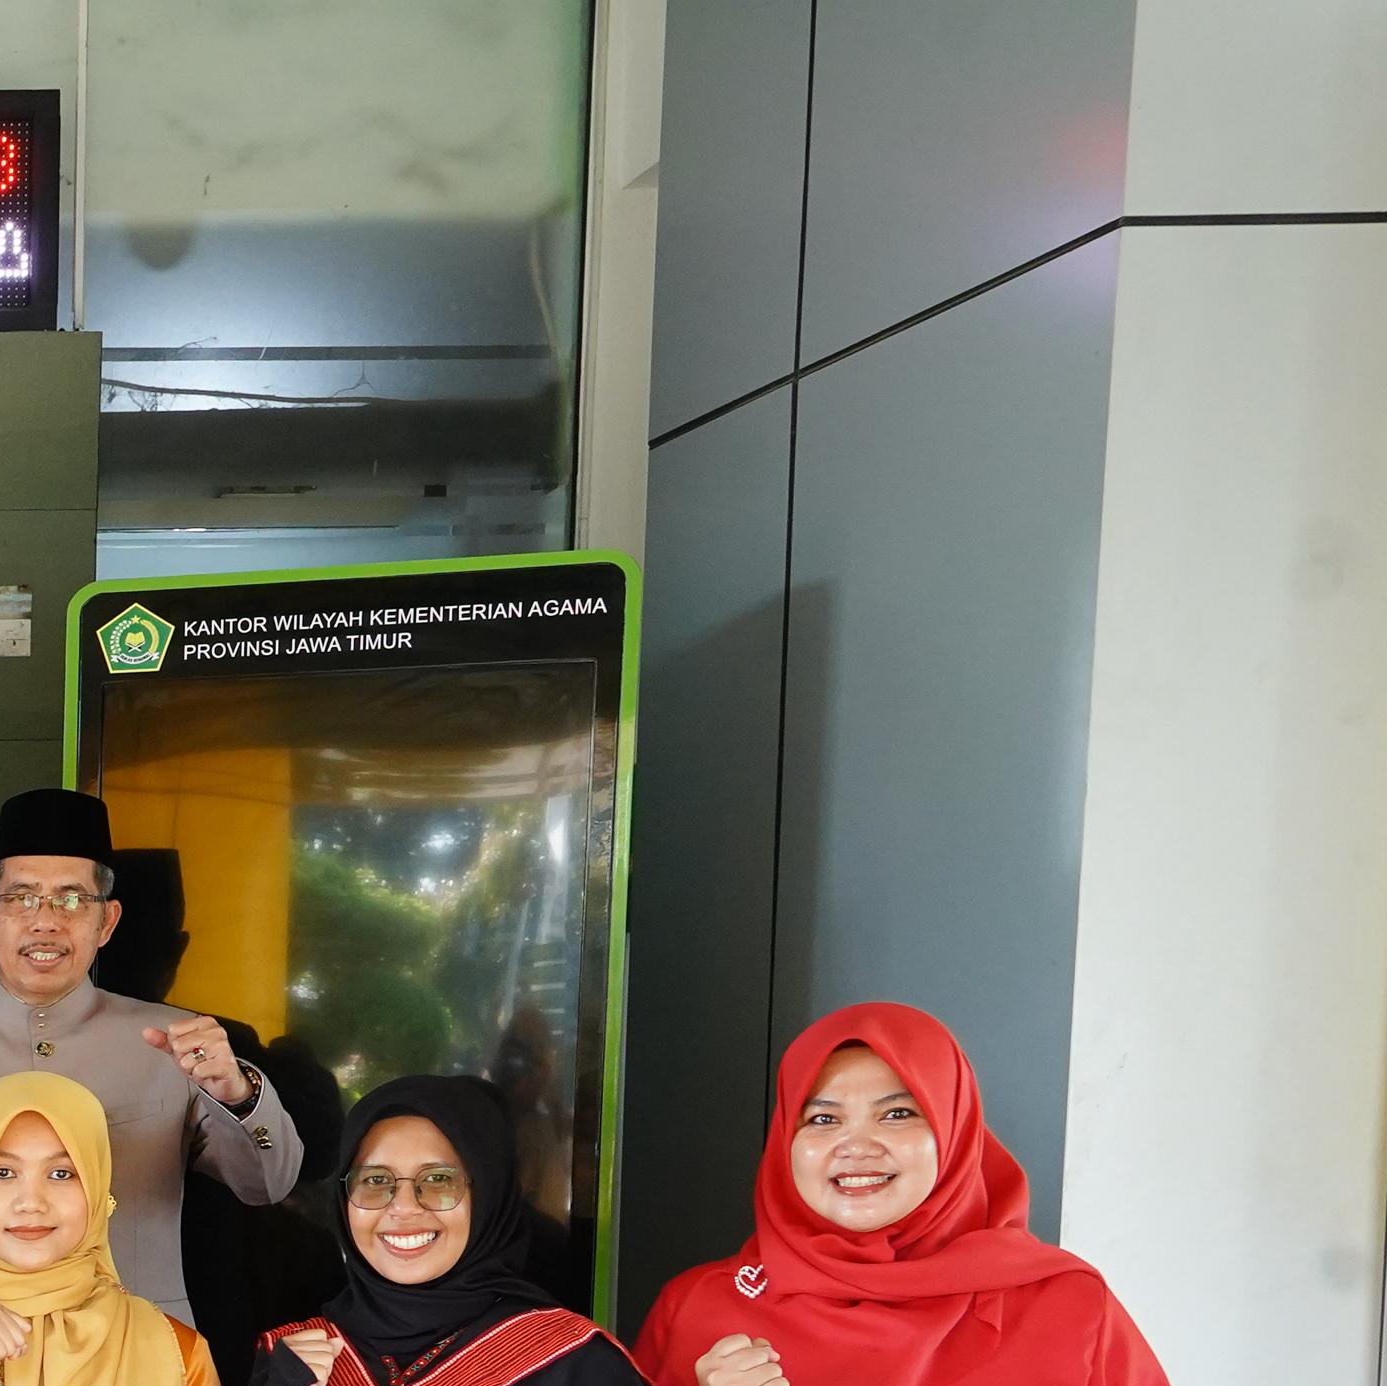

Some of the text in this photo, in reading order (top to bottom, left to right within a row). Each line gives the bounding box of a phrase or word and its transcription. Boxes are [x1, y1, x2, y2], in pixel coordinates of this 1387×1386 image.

[183, 597, 607, 637] KANTOR WILAYAH KEMENTERIAN AGAMA
[183, 632, 413, 661] PROVINSI JAWA TIMUR
